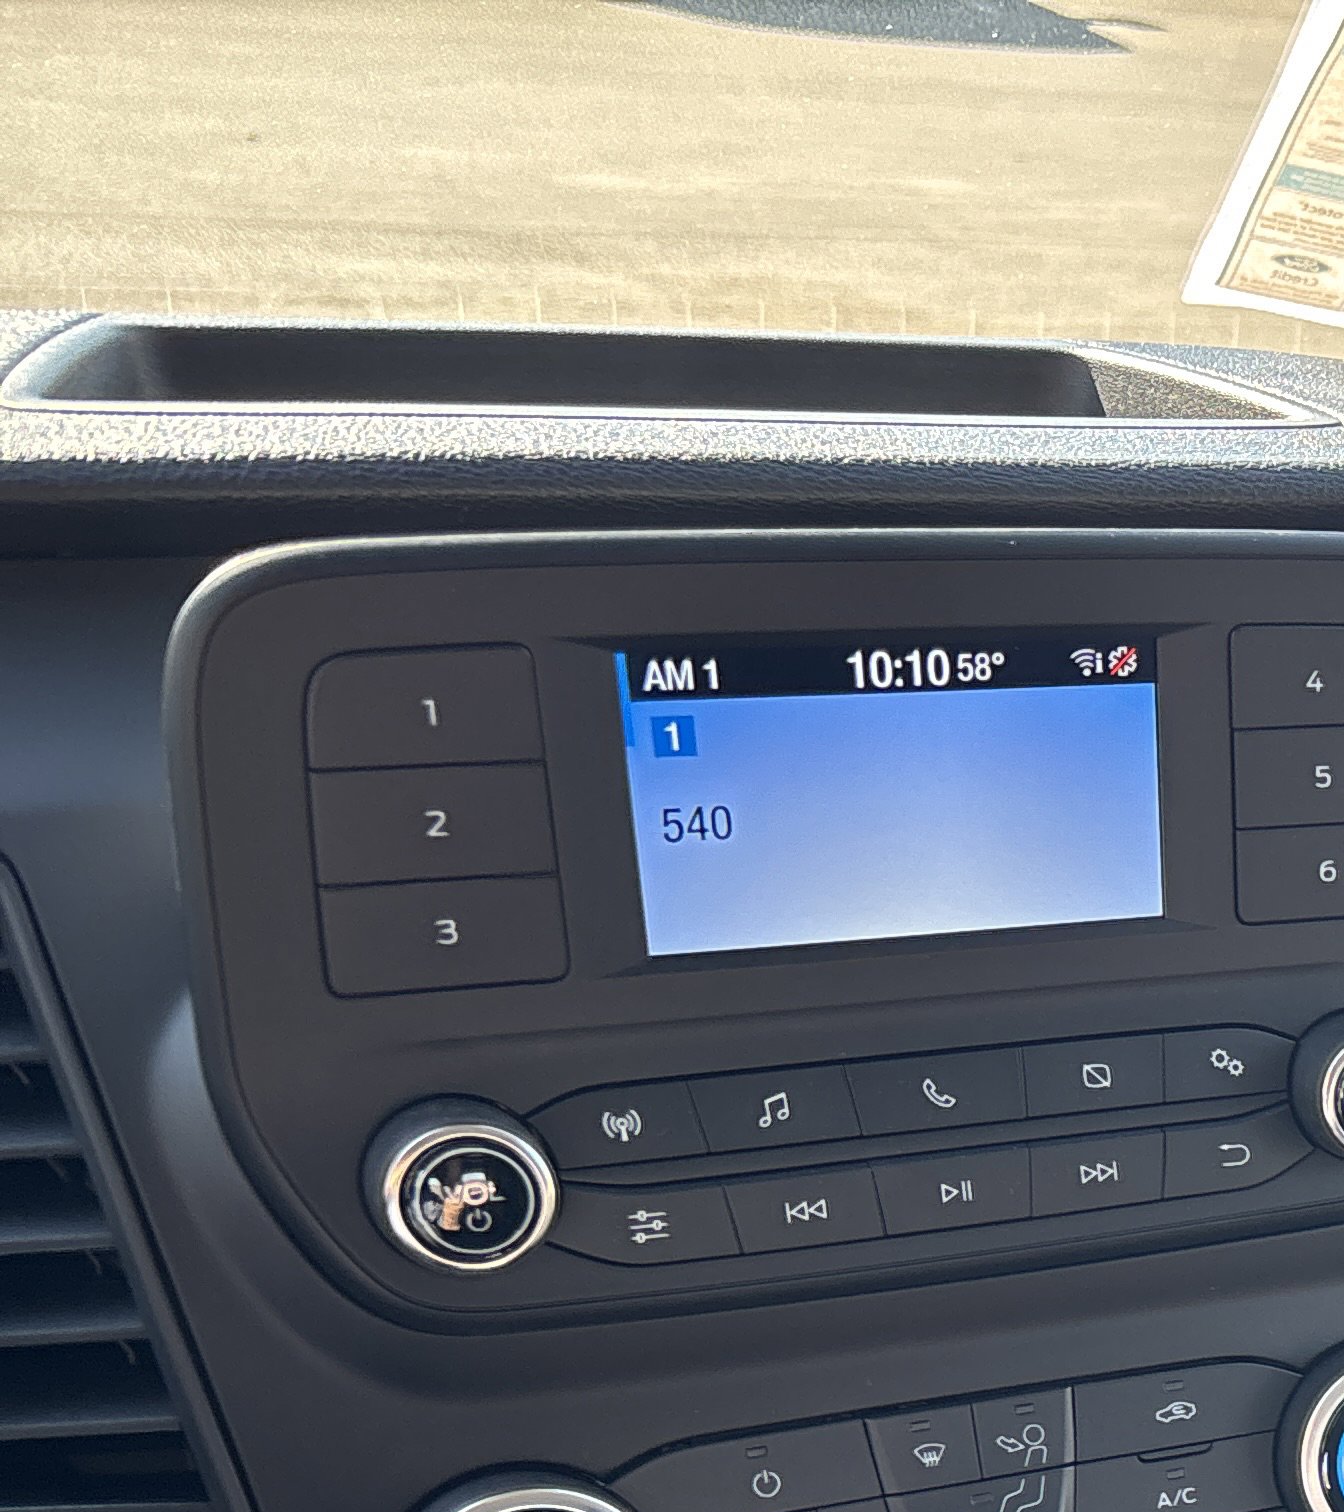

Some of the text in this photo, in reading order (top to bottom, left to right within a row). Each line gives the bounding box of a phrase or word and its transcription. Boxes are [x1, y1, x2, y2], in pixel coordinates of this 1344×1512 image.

[643, 658, 720, 692] AM 1
[847, 649, 1005, 689] 10:10 58°
[1306, 670, 1324, 693] 4
[420, 697, 439, 727] 1
[662, 721, 682, 753] 1
[1315, 765, 1333, 789] 5
[424, 810, 450, 838] 2
[662, 805, 733, 844] 540
[1319, 860, 1337, 882] 6
[433, 918, 460, 945] 3
[1156, 1487, 1198, 1511] A/C
